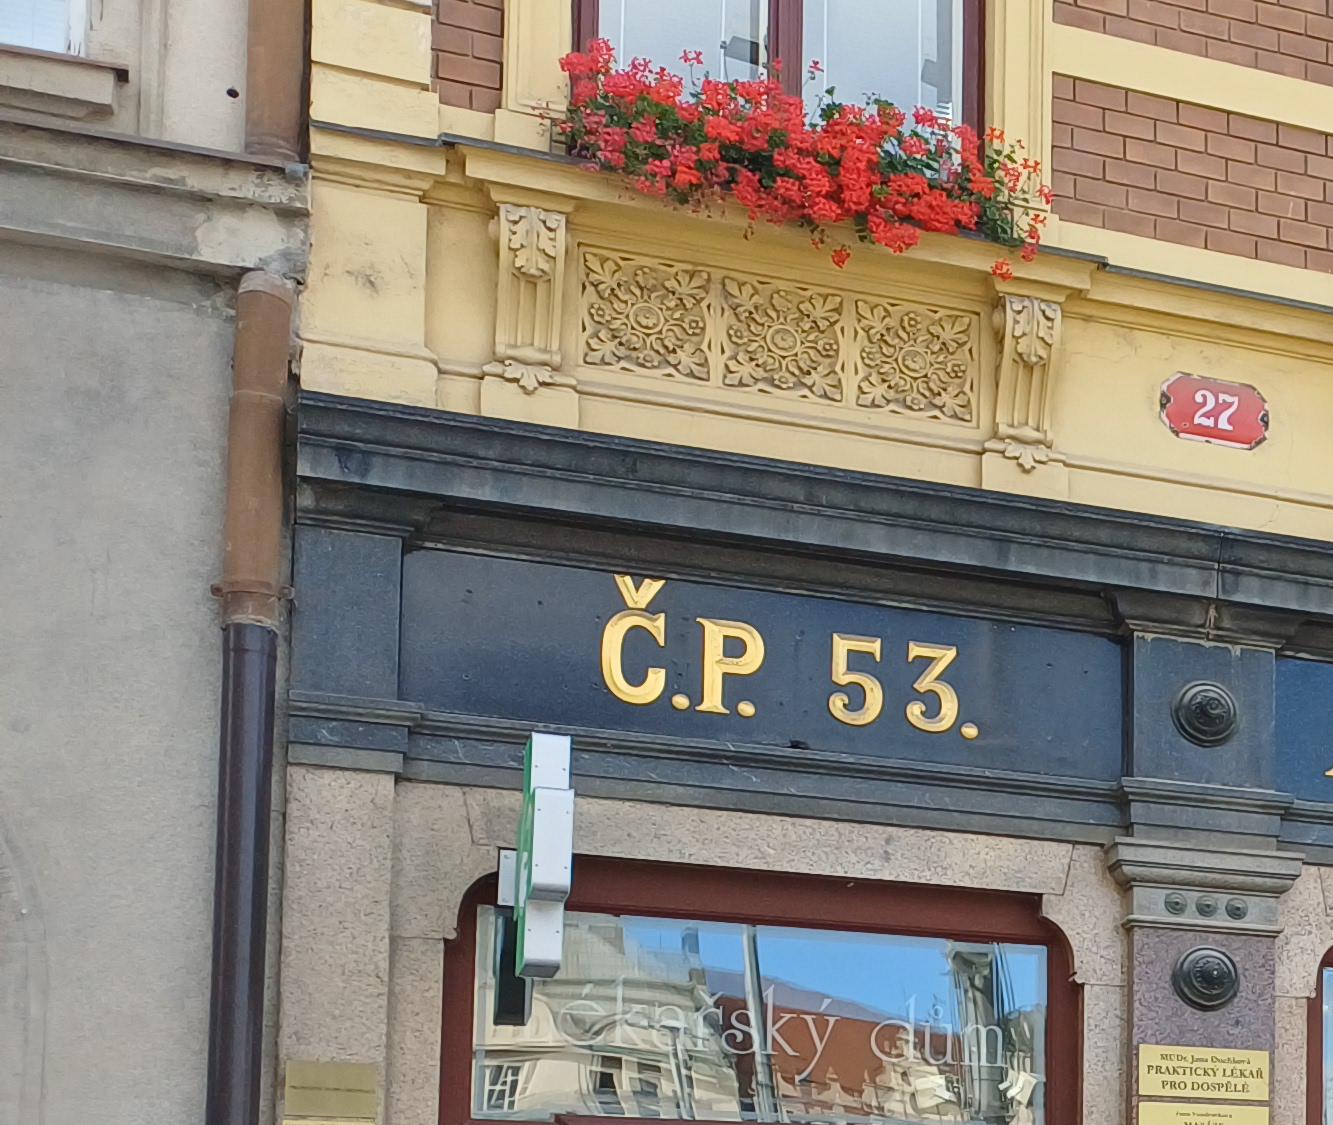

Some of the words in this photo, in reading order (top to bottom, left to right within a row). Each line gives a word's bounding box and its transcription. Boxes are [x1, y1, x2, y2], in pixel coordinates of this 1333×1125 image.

[1193, 389, 1239, 431] 27
[601, 573, 766, 718] Č.P.
[828, 632, 980, 740] 53.
[550, 980, 841, 1083] ékařský
[869, 991, 1008, 1069] dům
[1146, 1064, 1219, 1078] PRAKTICKÝ
[1222, 1066, 1264, 1080] LÉKAŘ
[1161, 1080, 1187, 1091] PRO
[1191, 1080, 1251, 1094] DOSPĚLÉ
